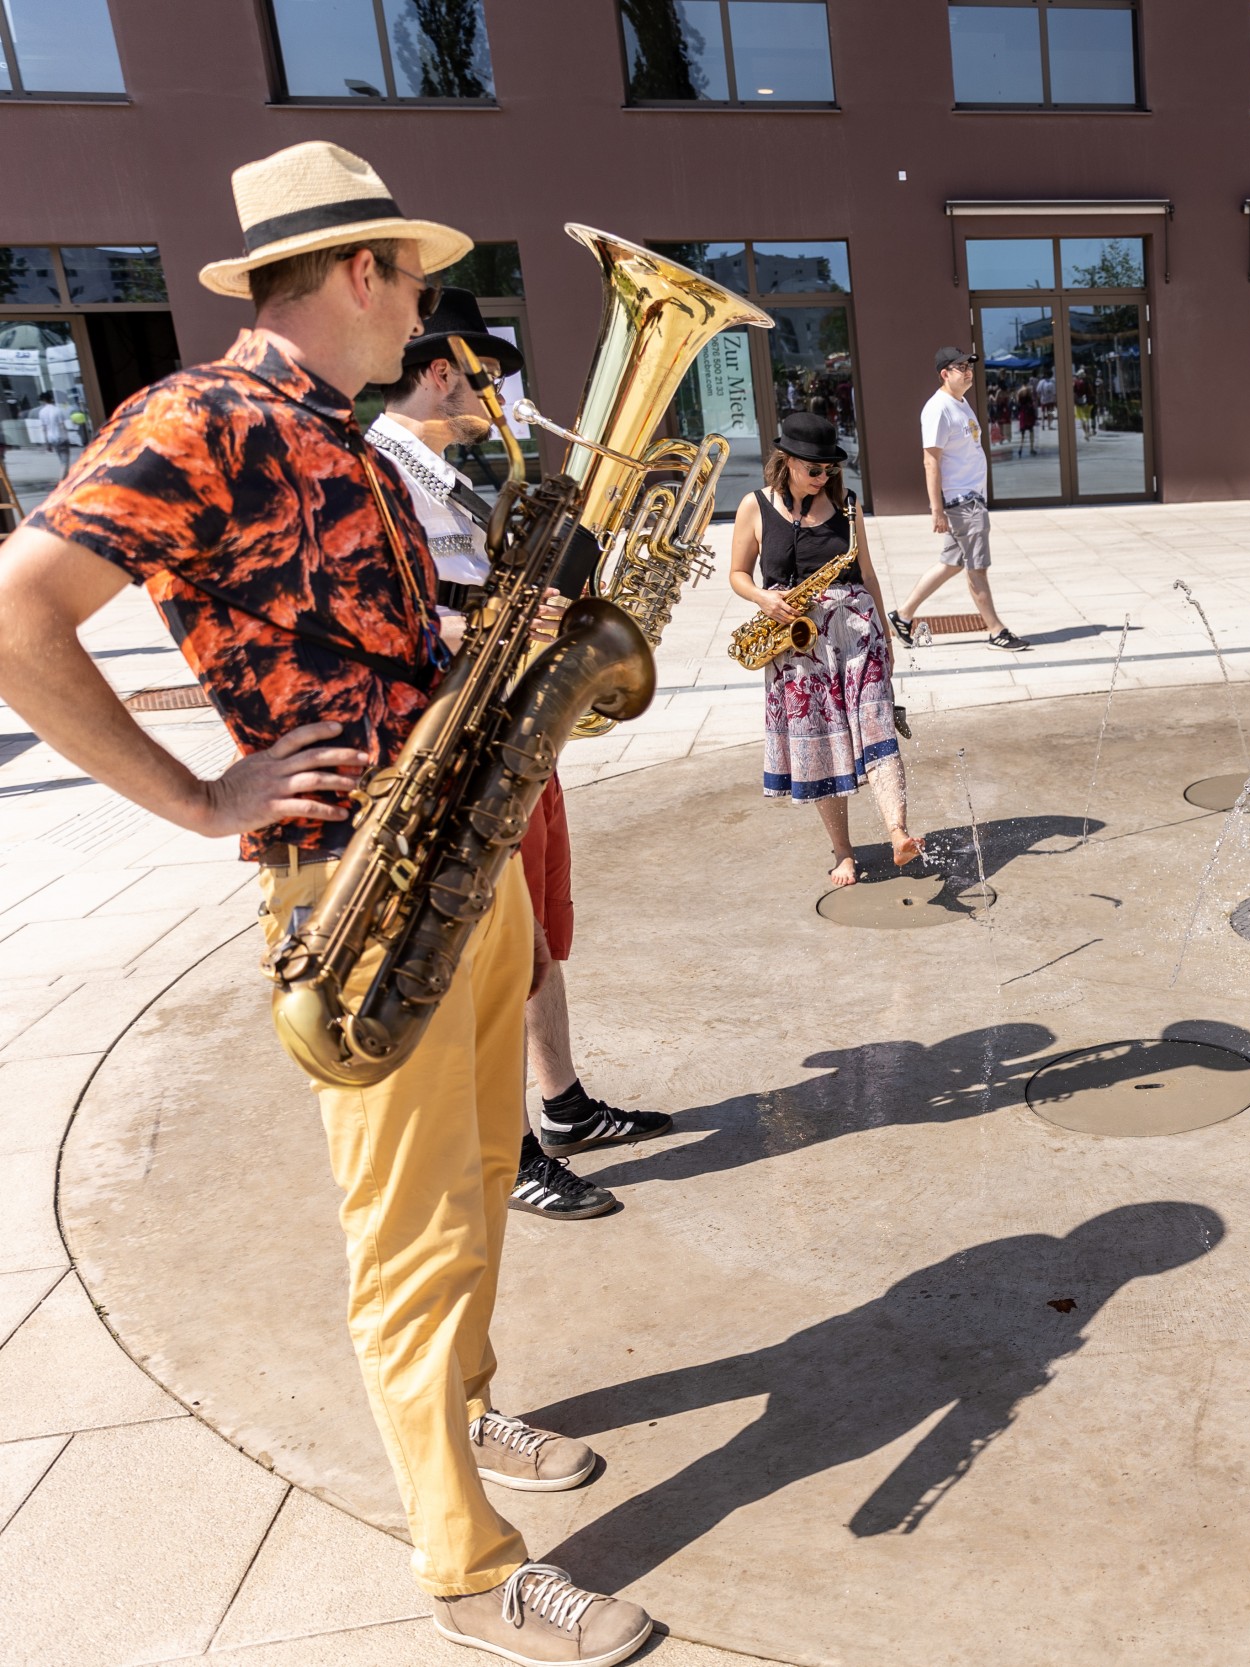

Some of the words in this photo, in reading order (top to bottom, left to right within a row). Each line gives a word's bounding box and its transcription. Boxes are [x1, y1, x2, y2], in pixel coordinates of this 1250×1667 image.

[713, 358, 722, 375] 500
[723, 336, 742, 371] Zur
[702, 344, 713, 397] mo.cbre.com
[715, 376, 723, 385] 21
[716, 385, 724, 397] 33
[727, 376, 747, 430] Miete
